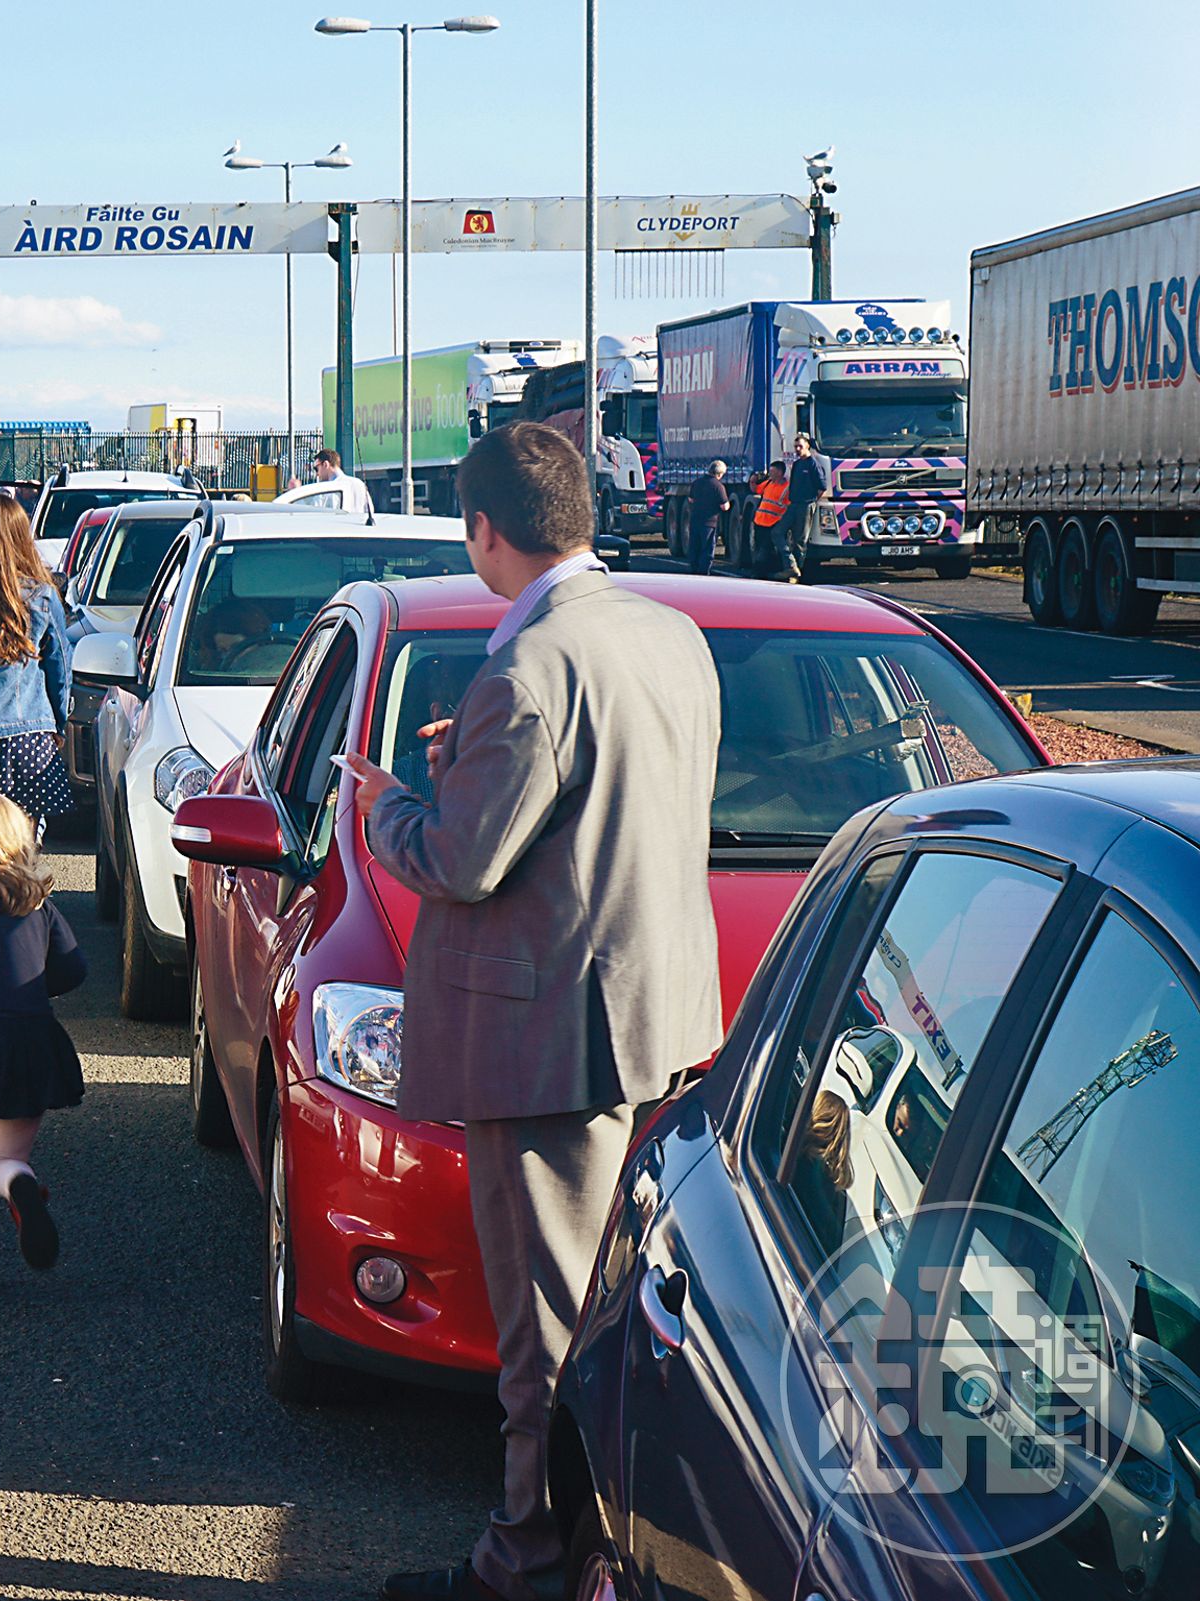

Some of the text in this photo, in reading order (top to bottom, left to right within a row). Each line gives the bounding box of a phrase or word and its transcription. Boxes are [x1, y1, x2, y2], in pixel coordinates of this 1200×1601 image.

[152, 206, 180, 221] Gu
[637, 216, 740, 231] CLYDEPORT
[13, 220, 254, 252] ÀIRD ROSAIN
[662, 350, 715, 395] ARRAN
[845, 362, 941, 375] ARRAN
[436, 380, 465, 429] food
